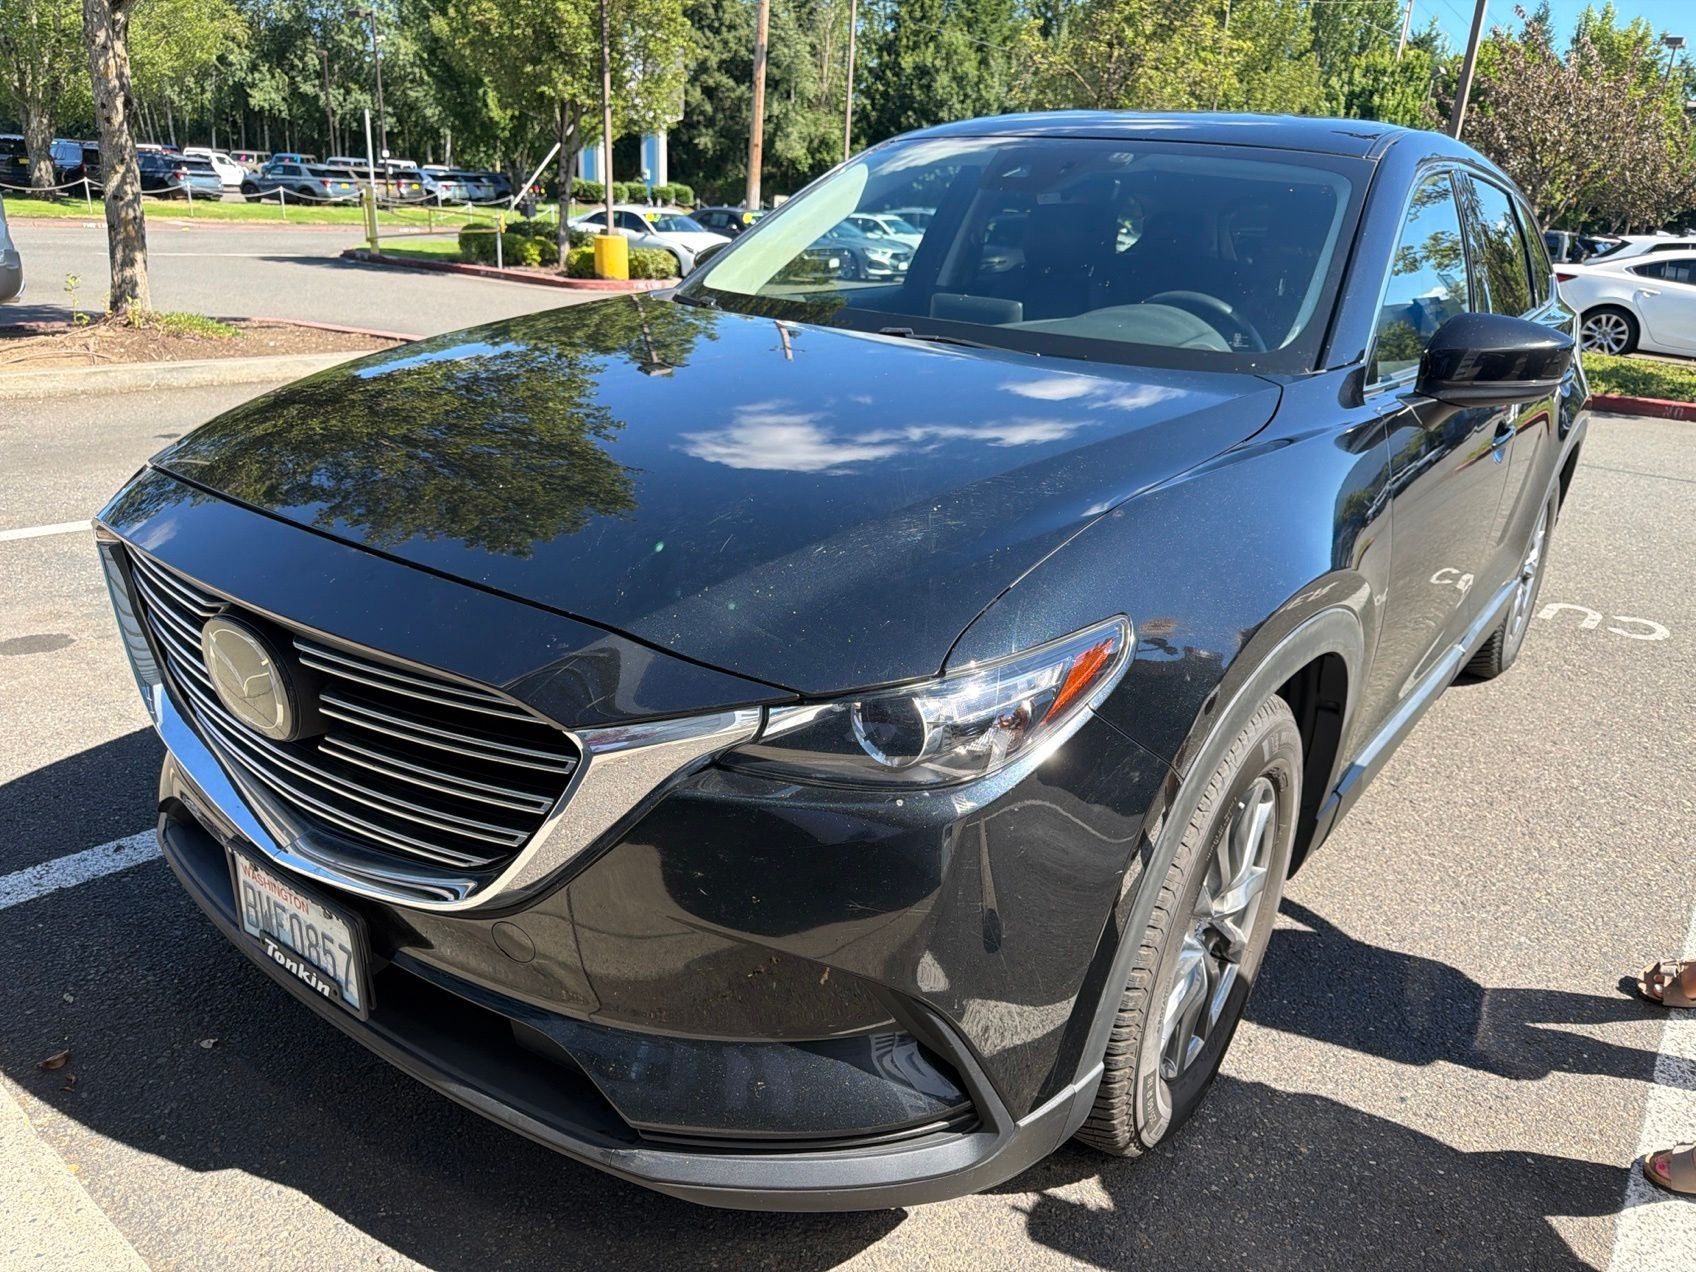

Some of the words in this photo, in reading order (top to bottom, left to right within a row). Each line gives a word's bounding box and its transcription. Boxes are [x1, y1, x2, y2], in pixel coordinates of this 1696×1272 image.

[242, 864, 309, 914] WASHINGTON
[244, 882, 352, 992] BWF0857
[265, 938, 331, 997] Tonkin
